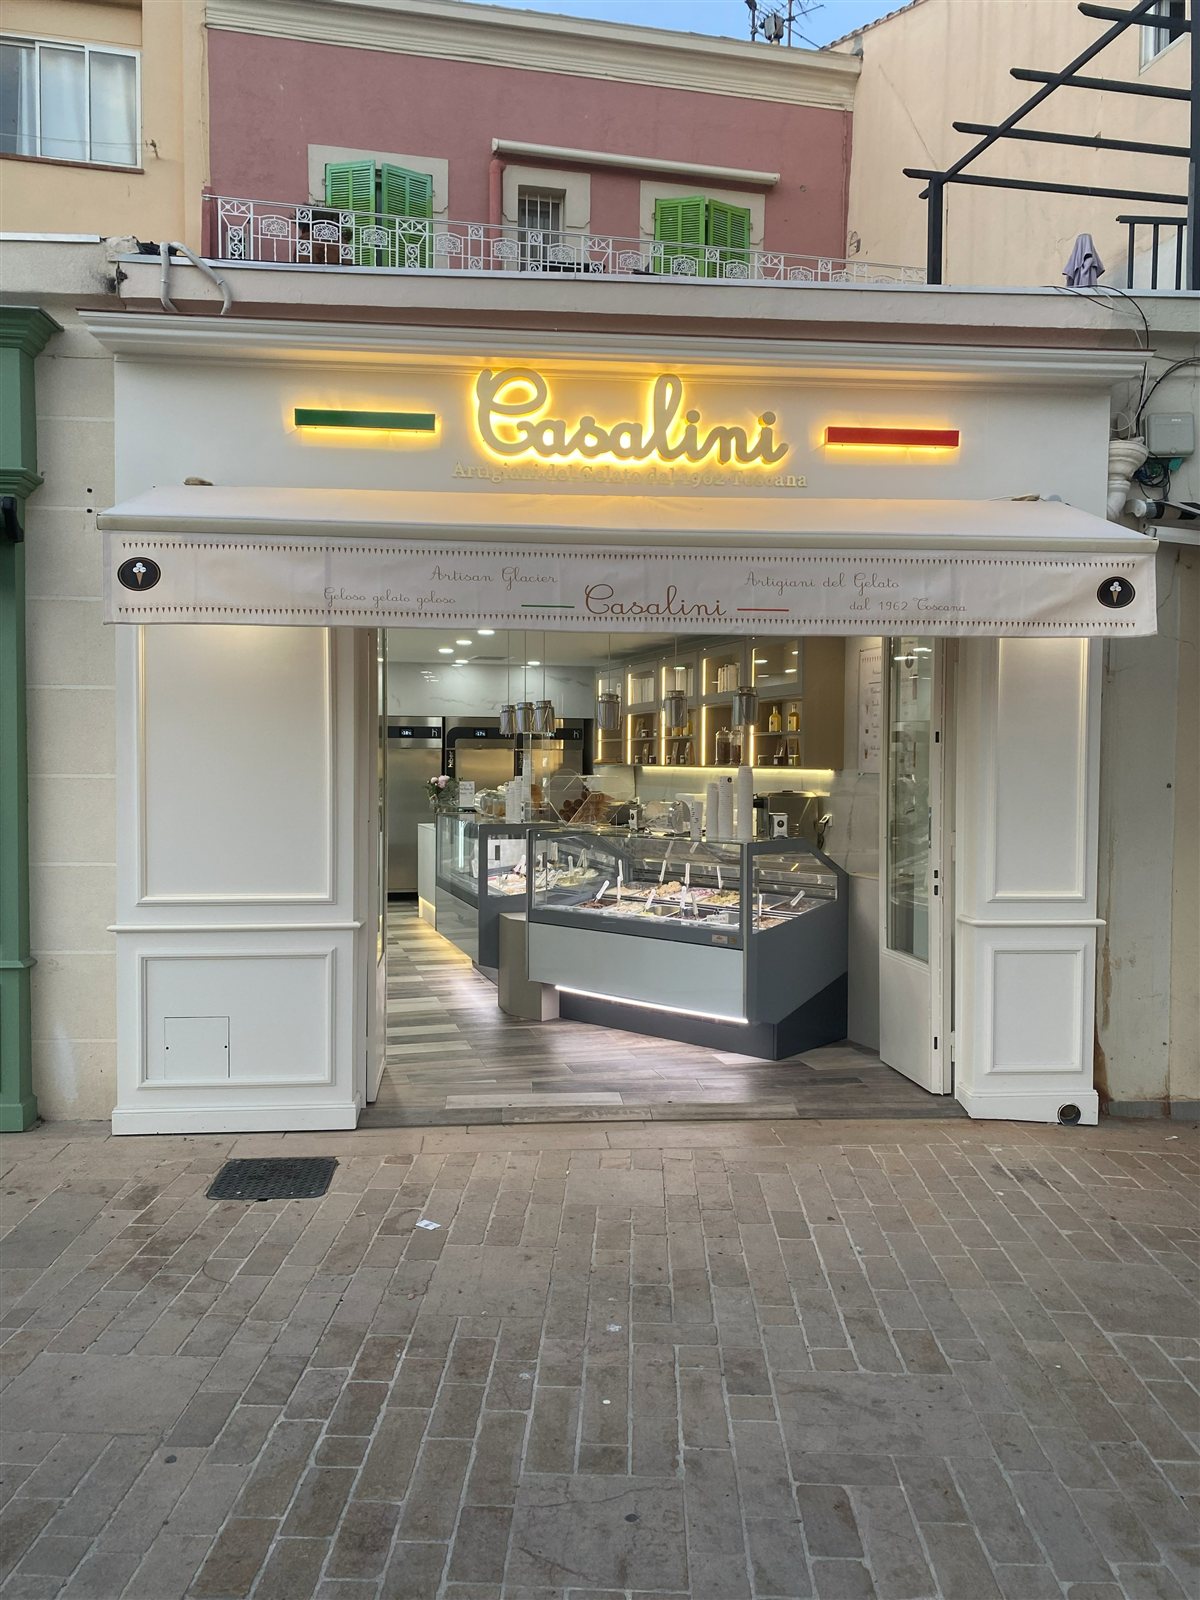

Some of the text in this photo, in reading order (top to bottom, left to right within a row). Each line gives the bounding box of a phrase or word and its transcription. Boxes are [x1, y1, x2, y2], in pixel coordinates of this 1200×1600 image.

[475, 367, 789, 465] Casalini
[545, 464, 574, 482] del
[649, 468, 675, 486] dal
[428, 565, 558, 591] Artisan Glacier
[744, 571, 900, 596] Artigiani del Gelato
[373, 589, 410, 608] gelato
[416, 590, 457, 610] goloso
[584, 583, 727, 616] Casalini
[849, 597, 966, 612] dal 1962 Toscana
